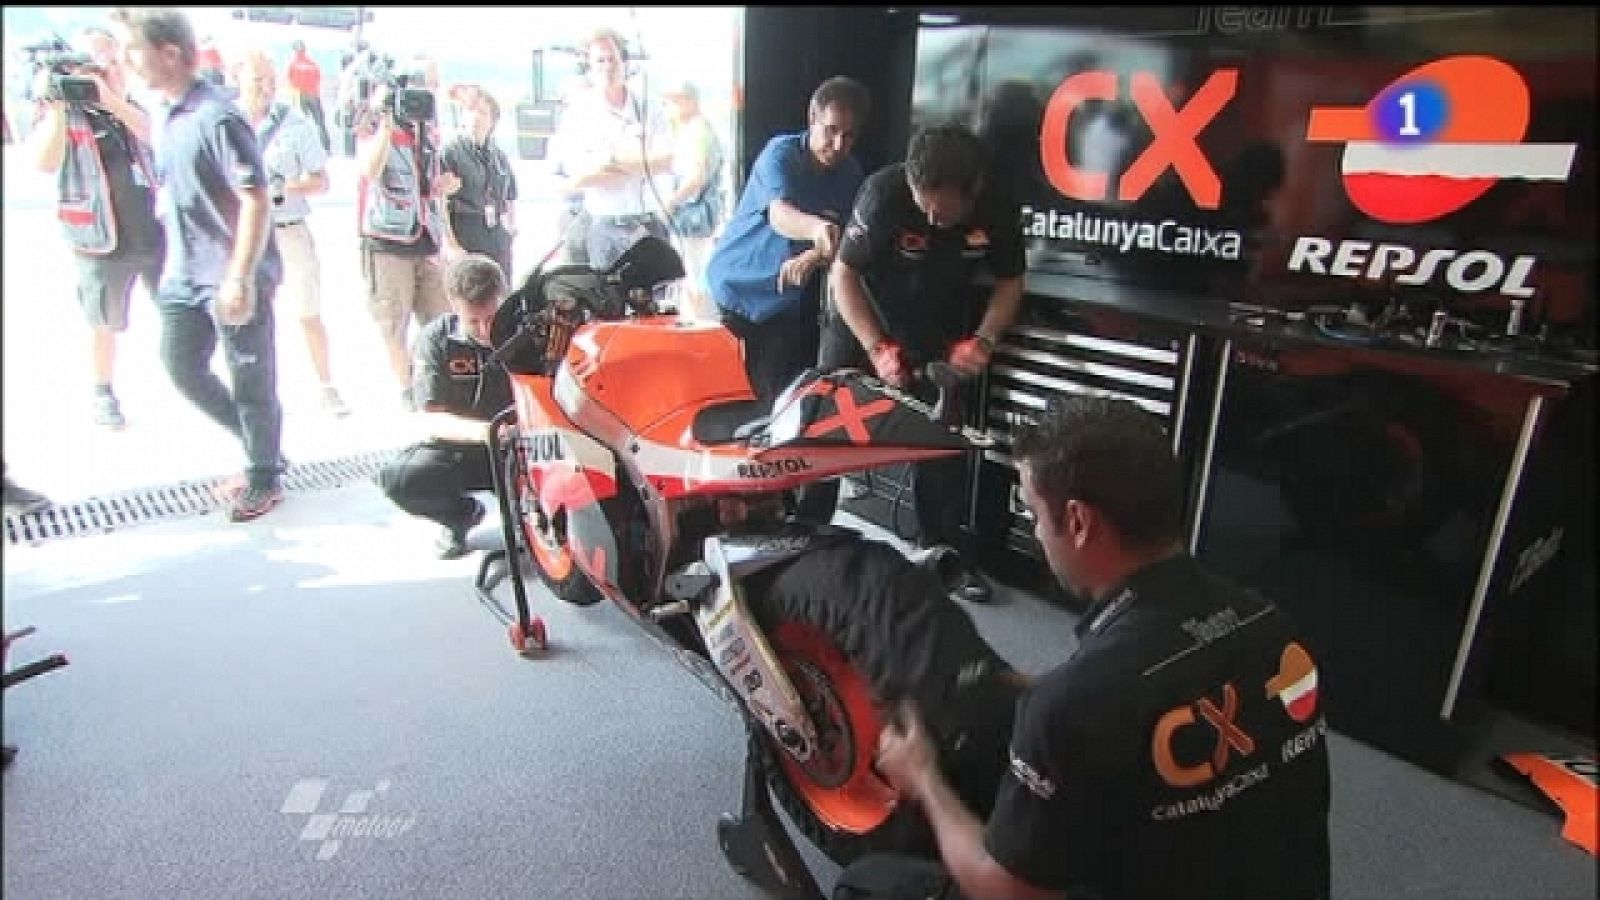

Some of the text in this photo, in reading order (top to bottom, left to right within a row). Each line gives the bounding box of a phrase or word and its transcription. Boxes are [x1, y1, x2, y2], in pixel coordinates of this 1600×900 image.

[1041, 69, 1239, 208] CX
[1288, 237, 1536, 297] REPSOL
[1151, 682, 1254, 787] CX
